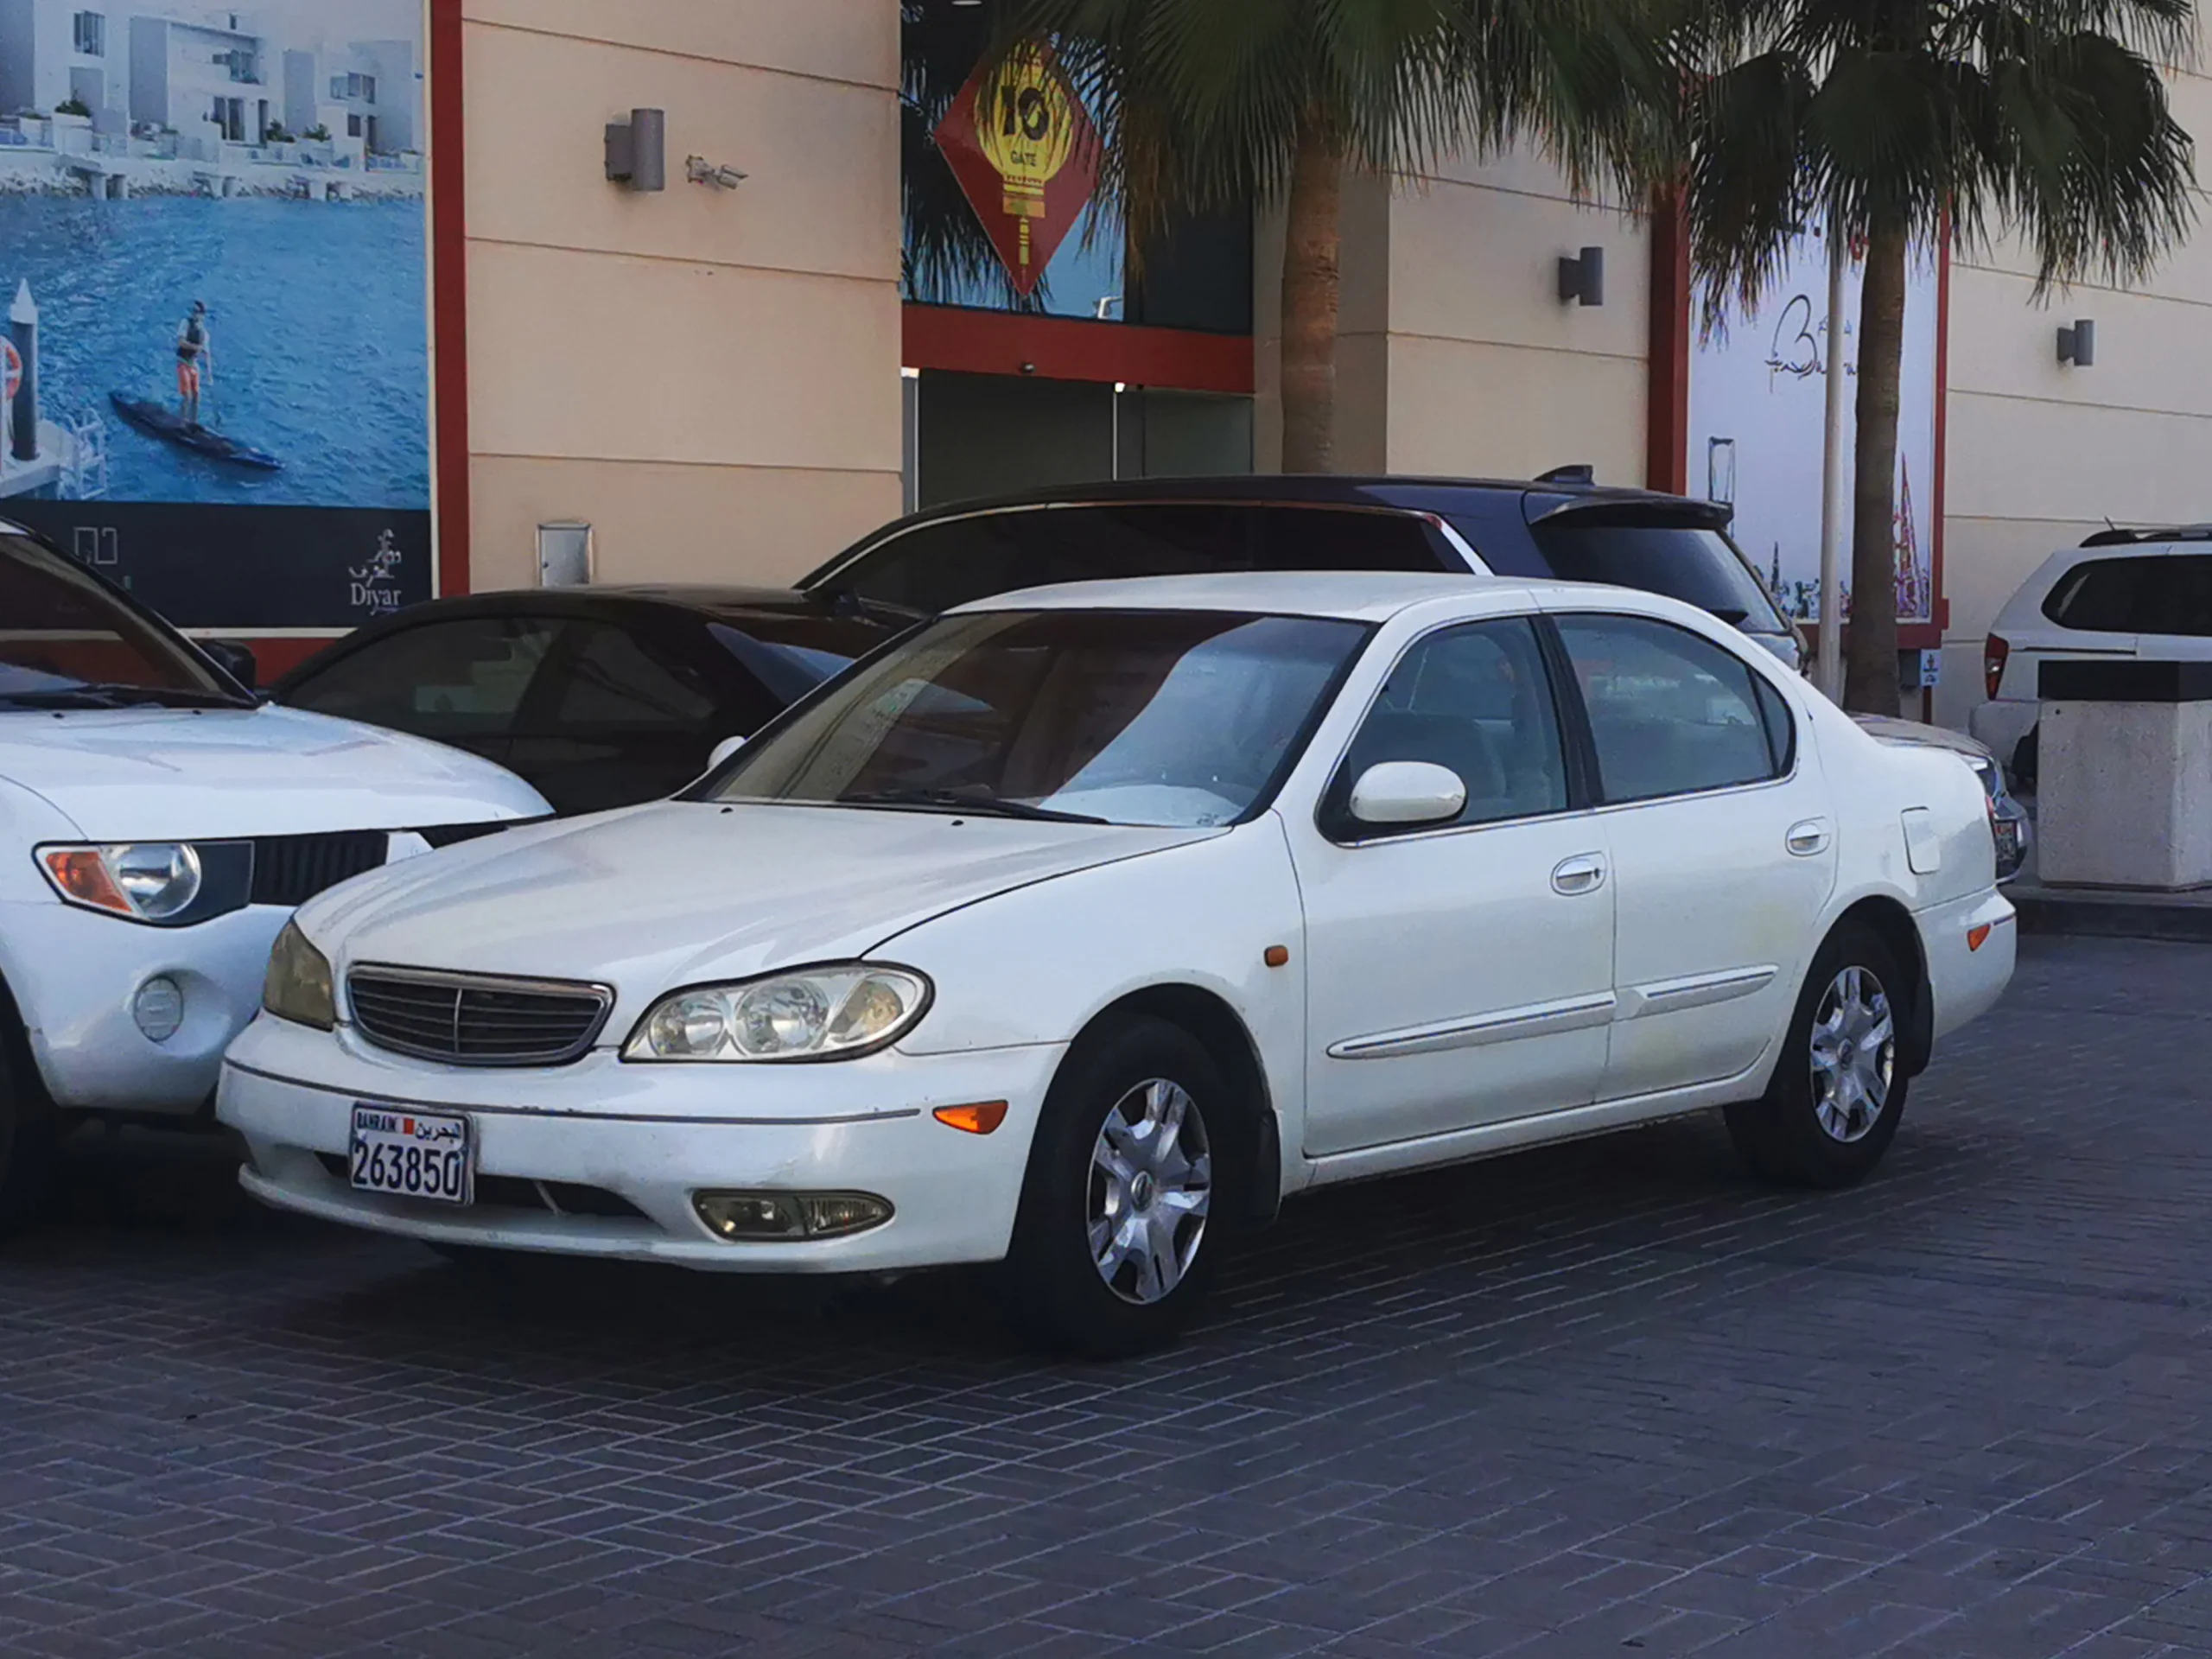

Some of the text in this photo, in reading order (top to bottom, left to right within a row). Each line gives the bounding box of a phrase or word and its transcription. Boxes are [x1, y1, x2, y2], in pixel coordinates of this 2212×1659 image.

[1001, 86, 1050, 141] 10
[1010, 150, 1037, 167] GATE
[350, 582, 402, 616] Diyar
[353, 1139, 462, 1197] 263850
